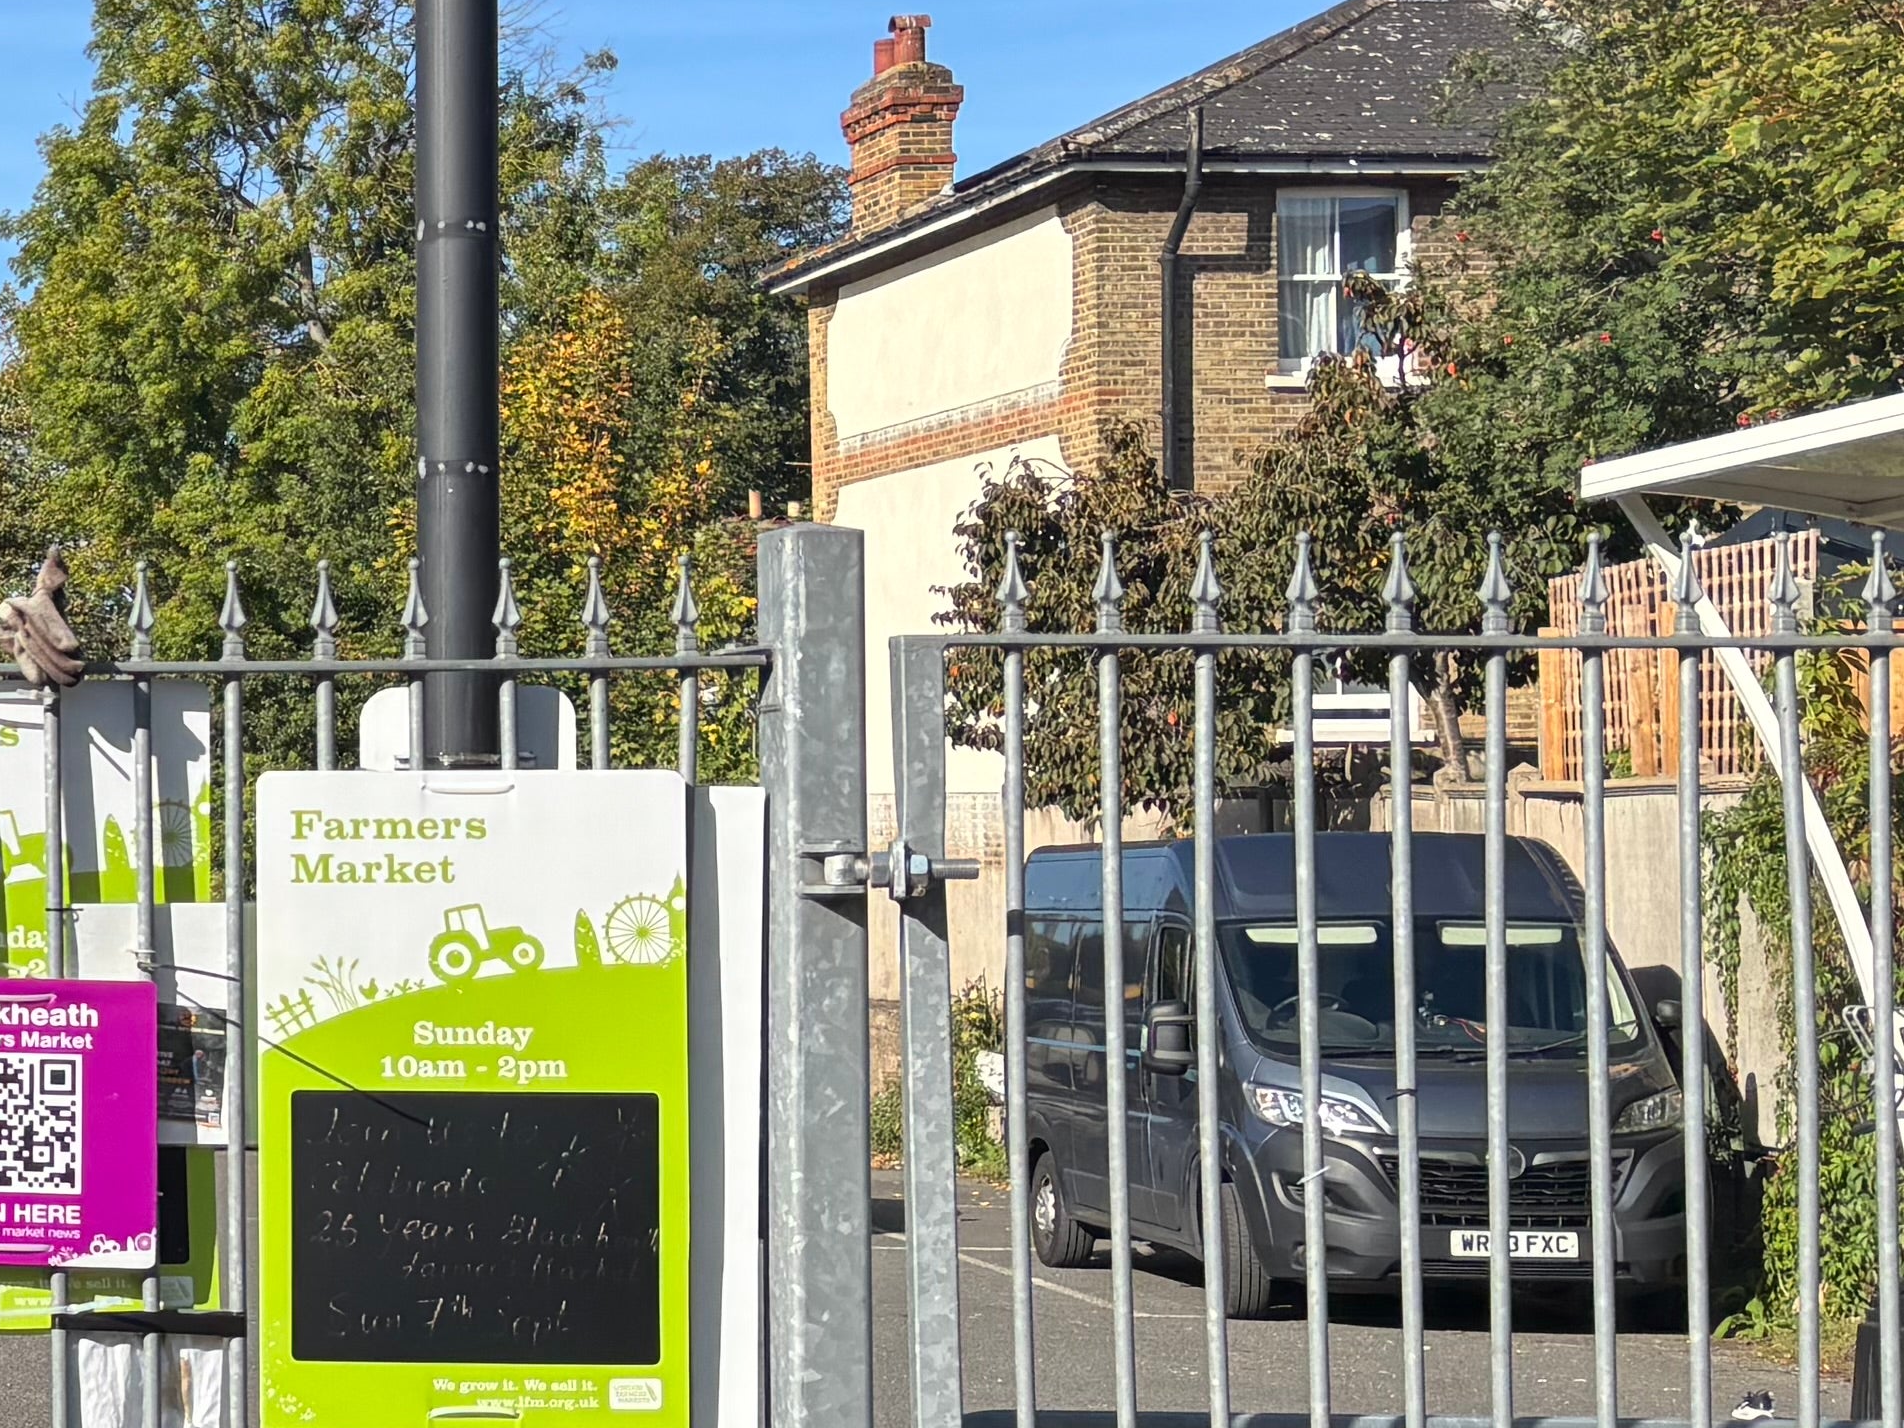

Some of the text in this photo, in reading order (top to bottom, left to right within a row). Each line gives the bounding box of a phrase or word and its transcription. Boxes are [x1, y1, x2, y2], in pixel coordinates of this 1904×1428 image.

[289, 809, 488, 841] Farmers
[289, 852, 456, 884] Market
[20, 1030, 94, 1050] Market
[412, 1020, 535, 1052] Sunday
[379, 1054, 569, 1085] 10am - 2pm
[13, 1203, 82, 1225] HERE
[2, 1227, 45, 1239] market
[48, 1229, 81, 1240] news
[309, 1209, 359, 1247] 25
[1461, 1234, 1569, 1254] WR3 FXC
[432, 1378, 599, 1396] We grow it. We sell it.
